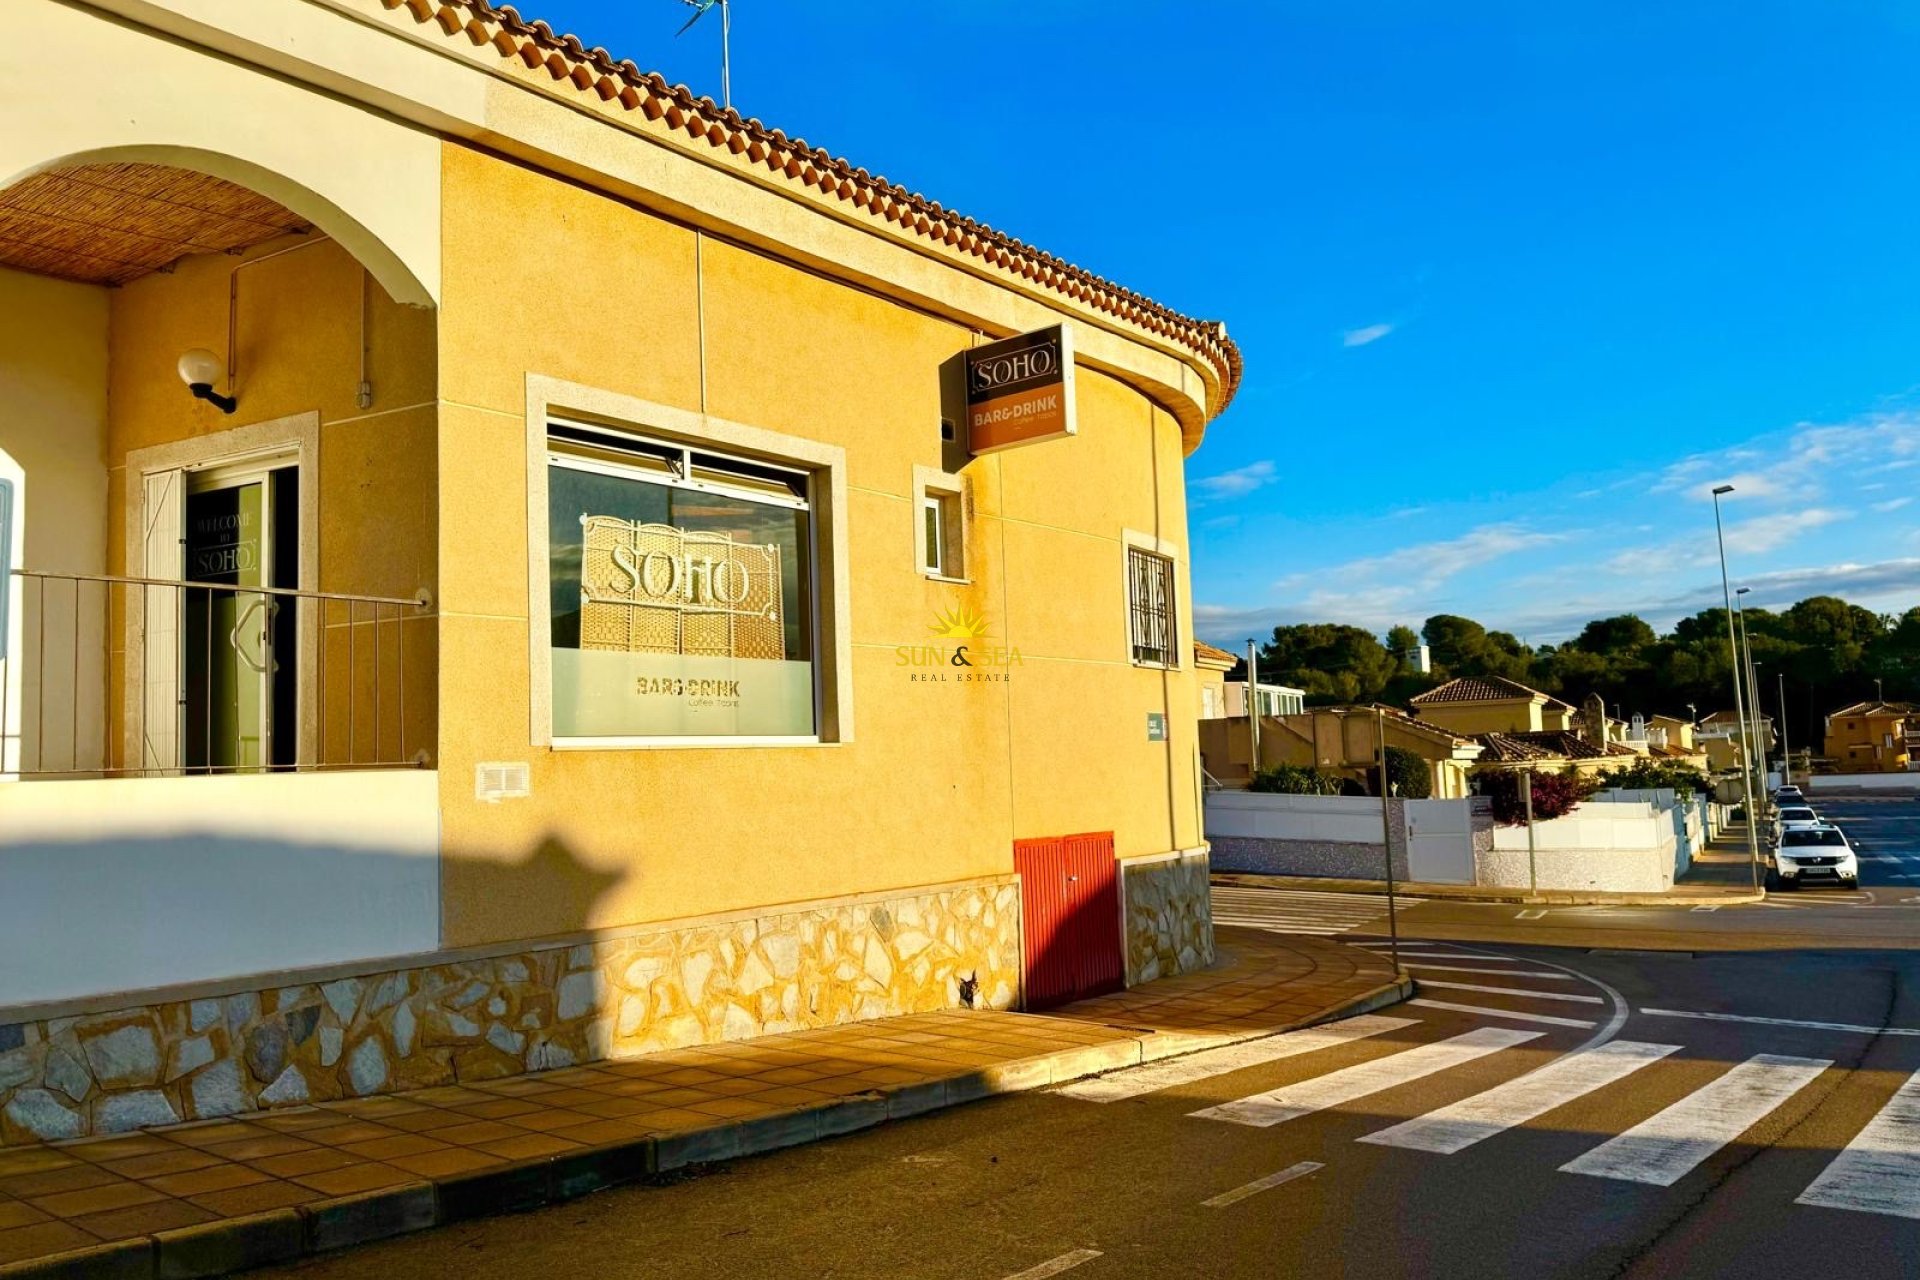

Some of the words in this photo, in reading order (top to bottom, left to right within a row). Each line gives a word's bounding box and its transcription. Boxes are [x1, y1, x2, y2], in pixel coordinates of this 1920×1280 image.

[978, 350, 1050, 388] SOHO
[199, 547, 251, 573] SOHO
[609, 541, 749, 603] SOHO
